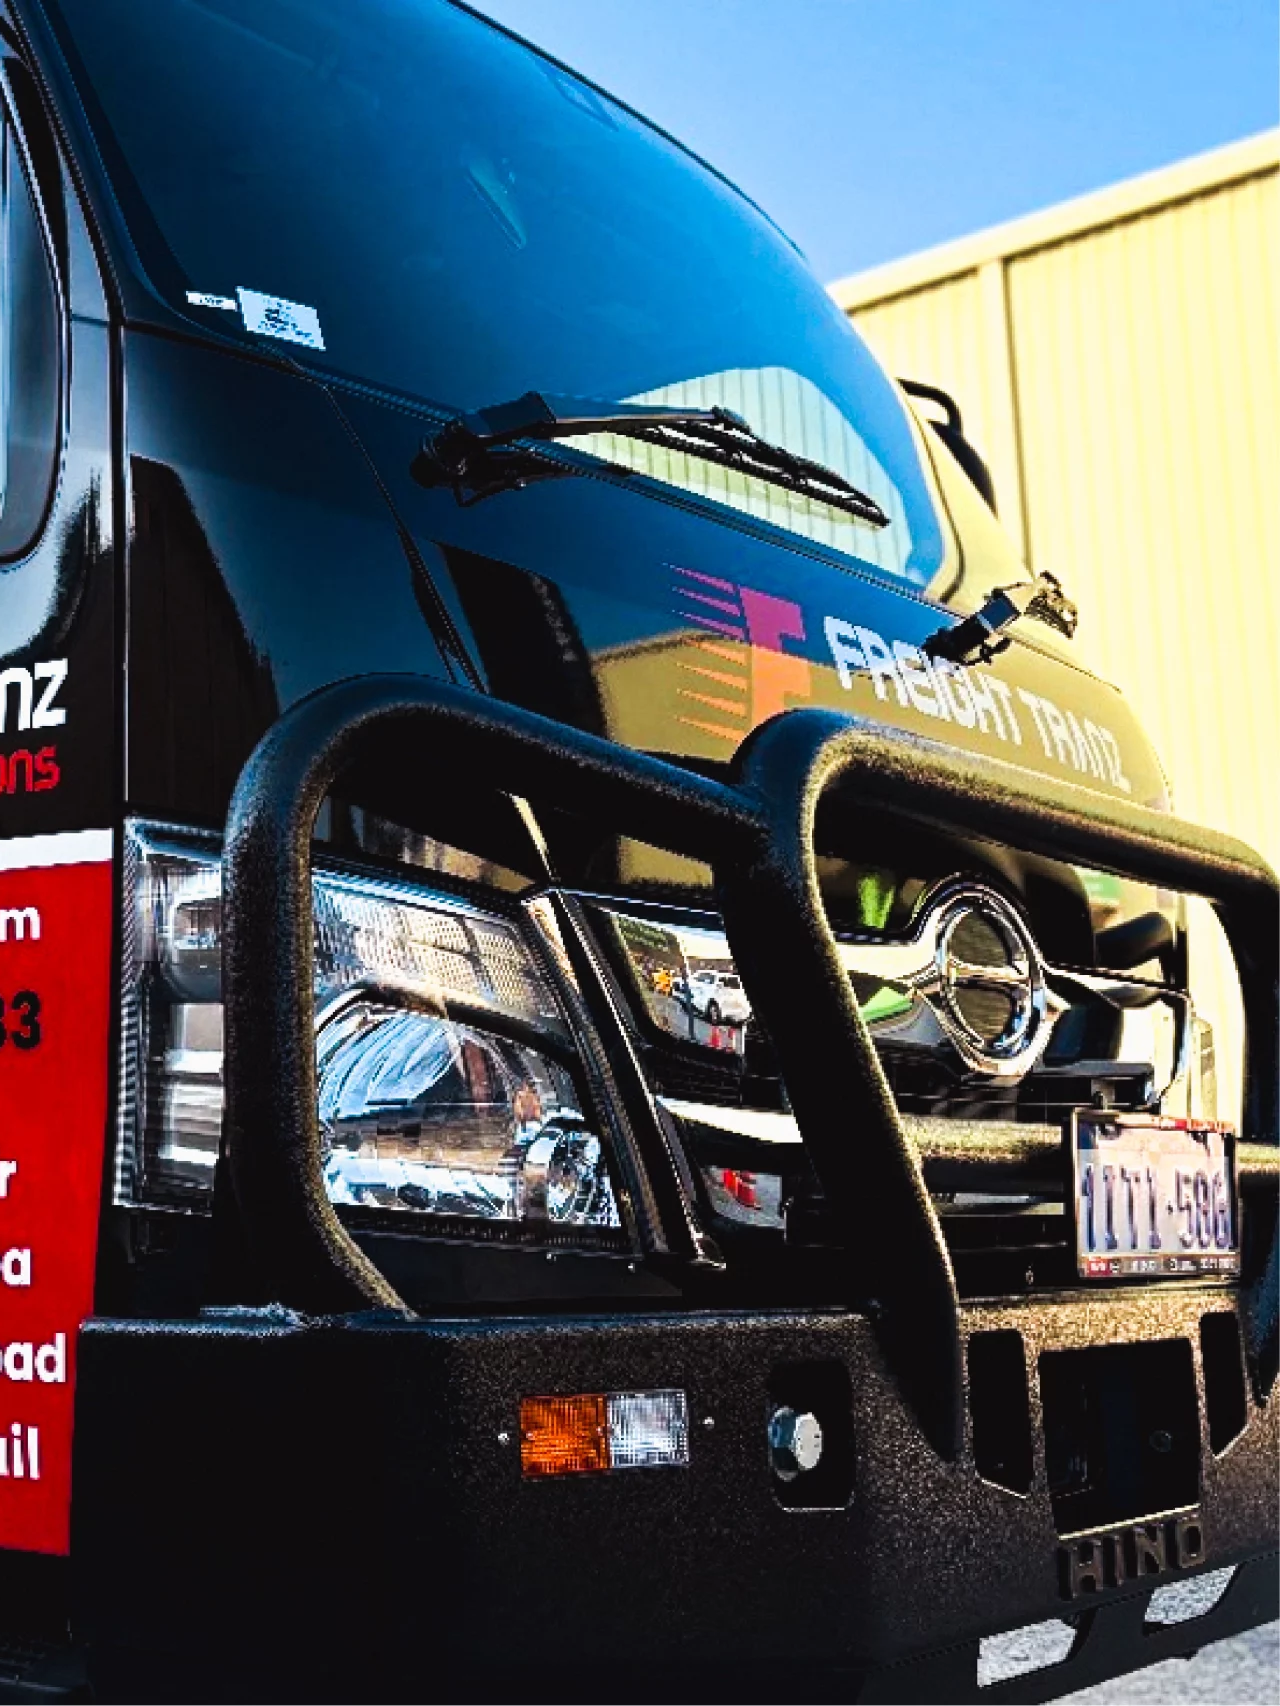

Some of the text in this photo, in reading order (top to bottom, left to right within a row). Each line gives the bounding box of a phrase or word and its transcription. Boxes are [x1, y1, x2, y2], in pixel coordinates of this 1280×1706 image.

[824, 614, 1131, 793] FREIGHT TRANZ
[1065, 1515, 1206, 1598] HINO
